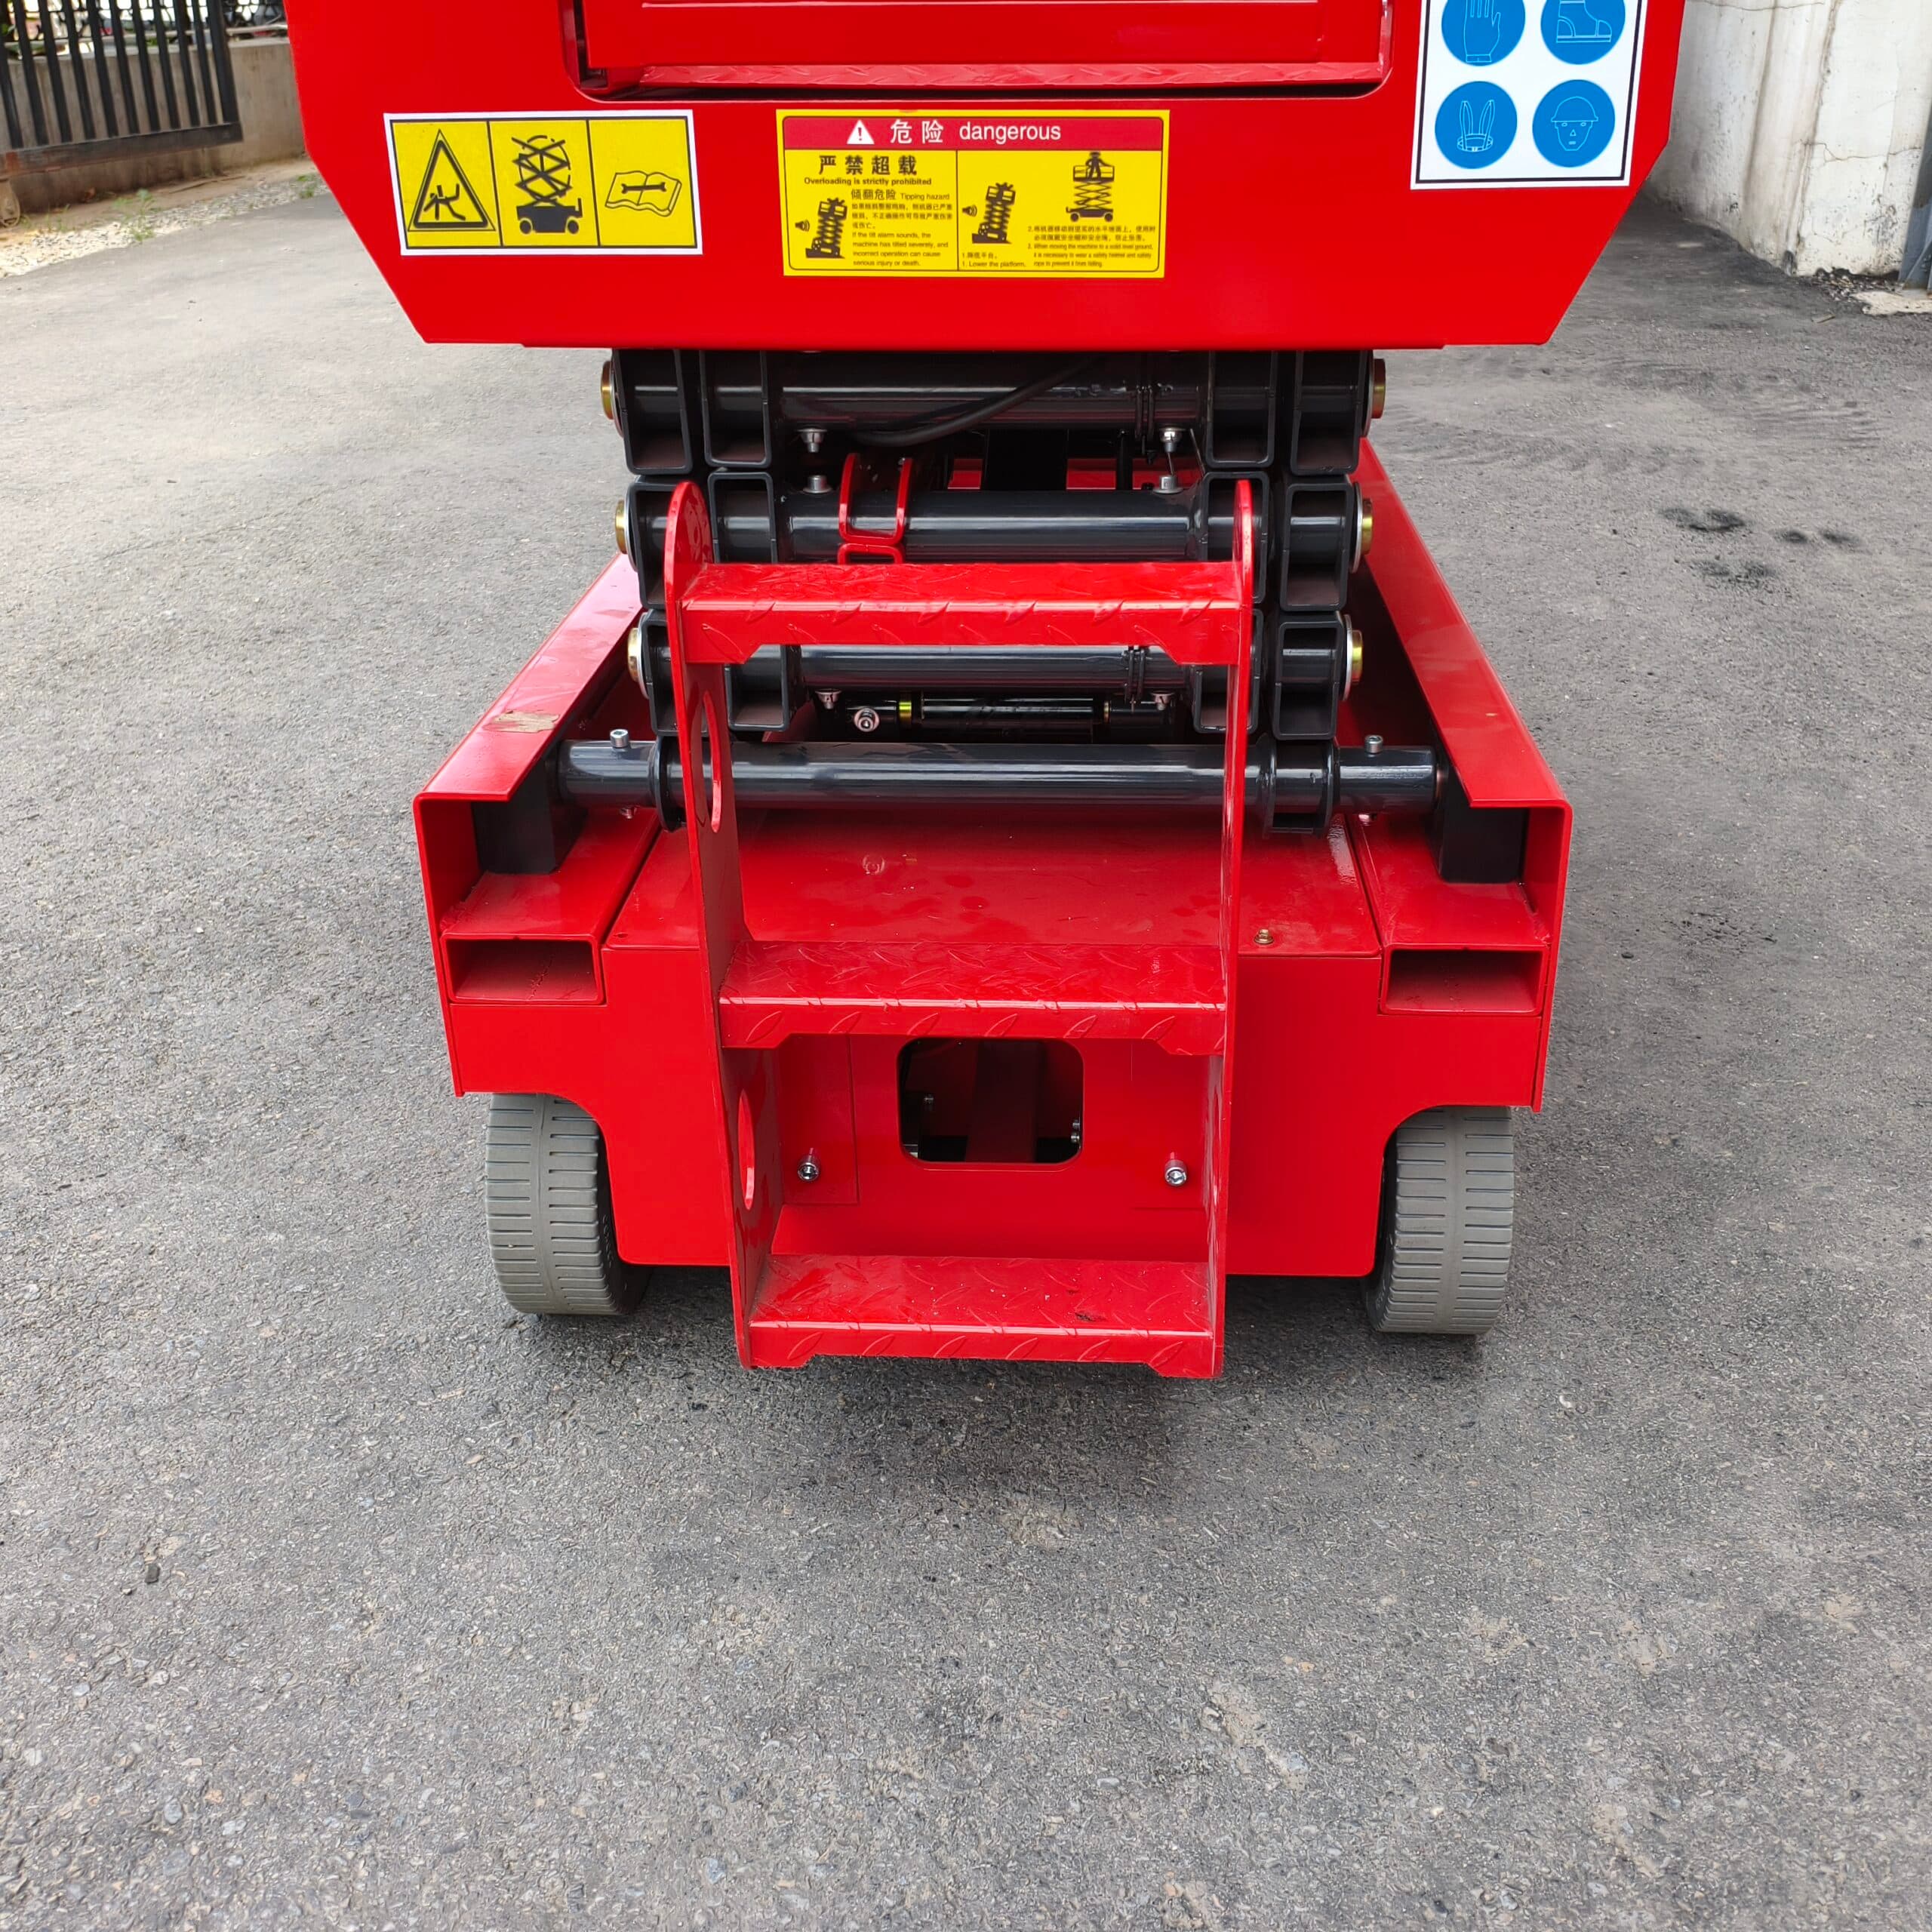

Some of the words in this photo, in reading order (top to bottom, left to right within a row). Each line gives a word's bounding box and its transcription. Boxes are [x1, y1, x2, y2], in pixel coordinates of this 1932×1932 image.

[890, 119, 944, 144] 危险
[958, 122, 1062, 144] dangerous
[818, 155, 918, 176] 严禁超载
[804, 177, 851, 186] Overloading
[863, 177, 889, 186] strictly
[891, 177, 931, 186] prohibited
